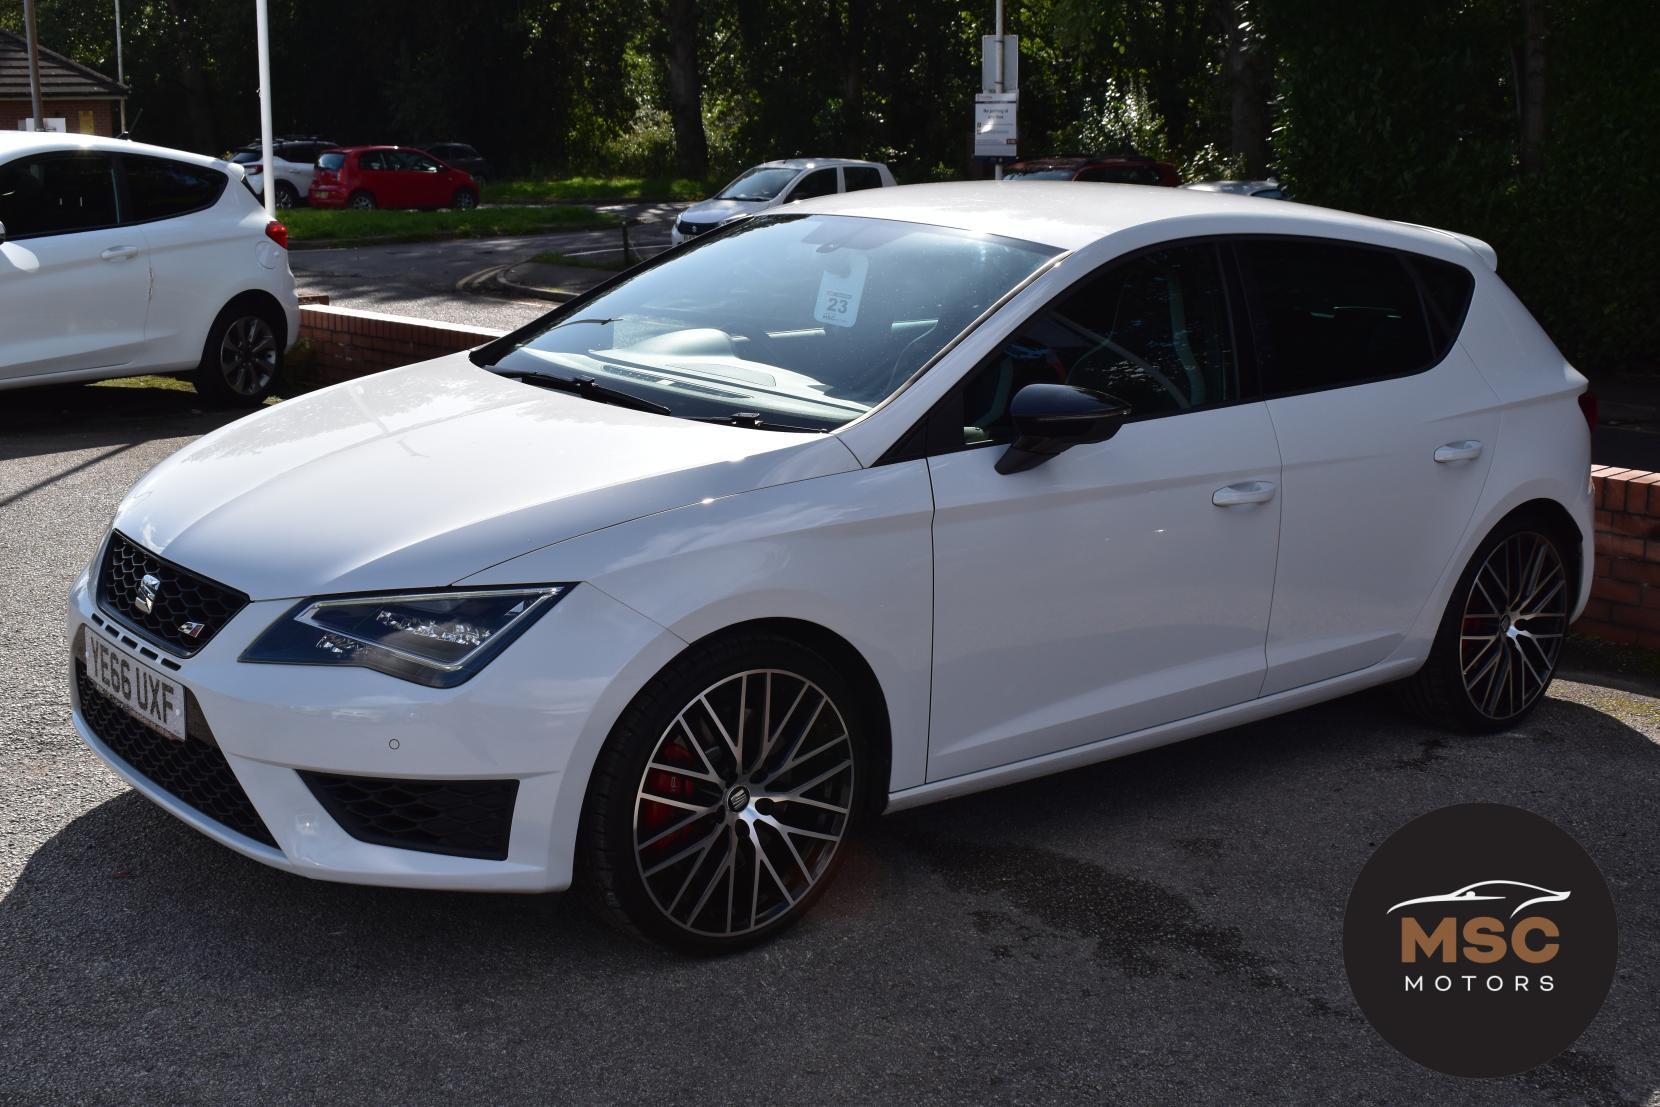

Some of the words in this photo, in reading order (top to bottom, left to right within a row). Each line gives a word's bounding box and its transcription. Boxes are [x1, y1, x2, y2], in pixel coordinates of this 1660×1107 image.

[827, 298, 848, 314] 23
[91, 636, 132, 701] YE66
[135, 667, 174, 724] UXF
